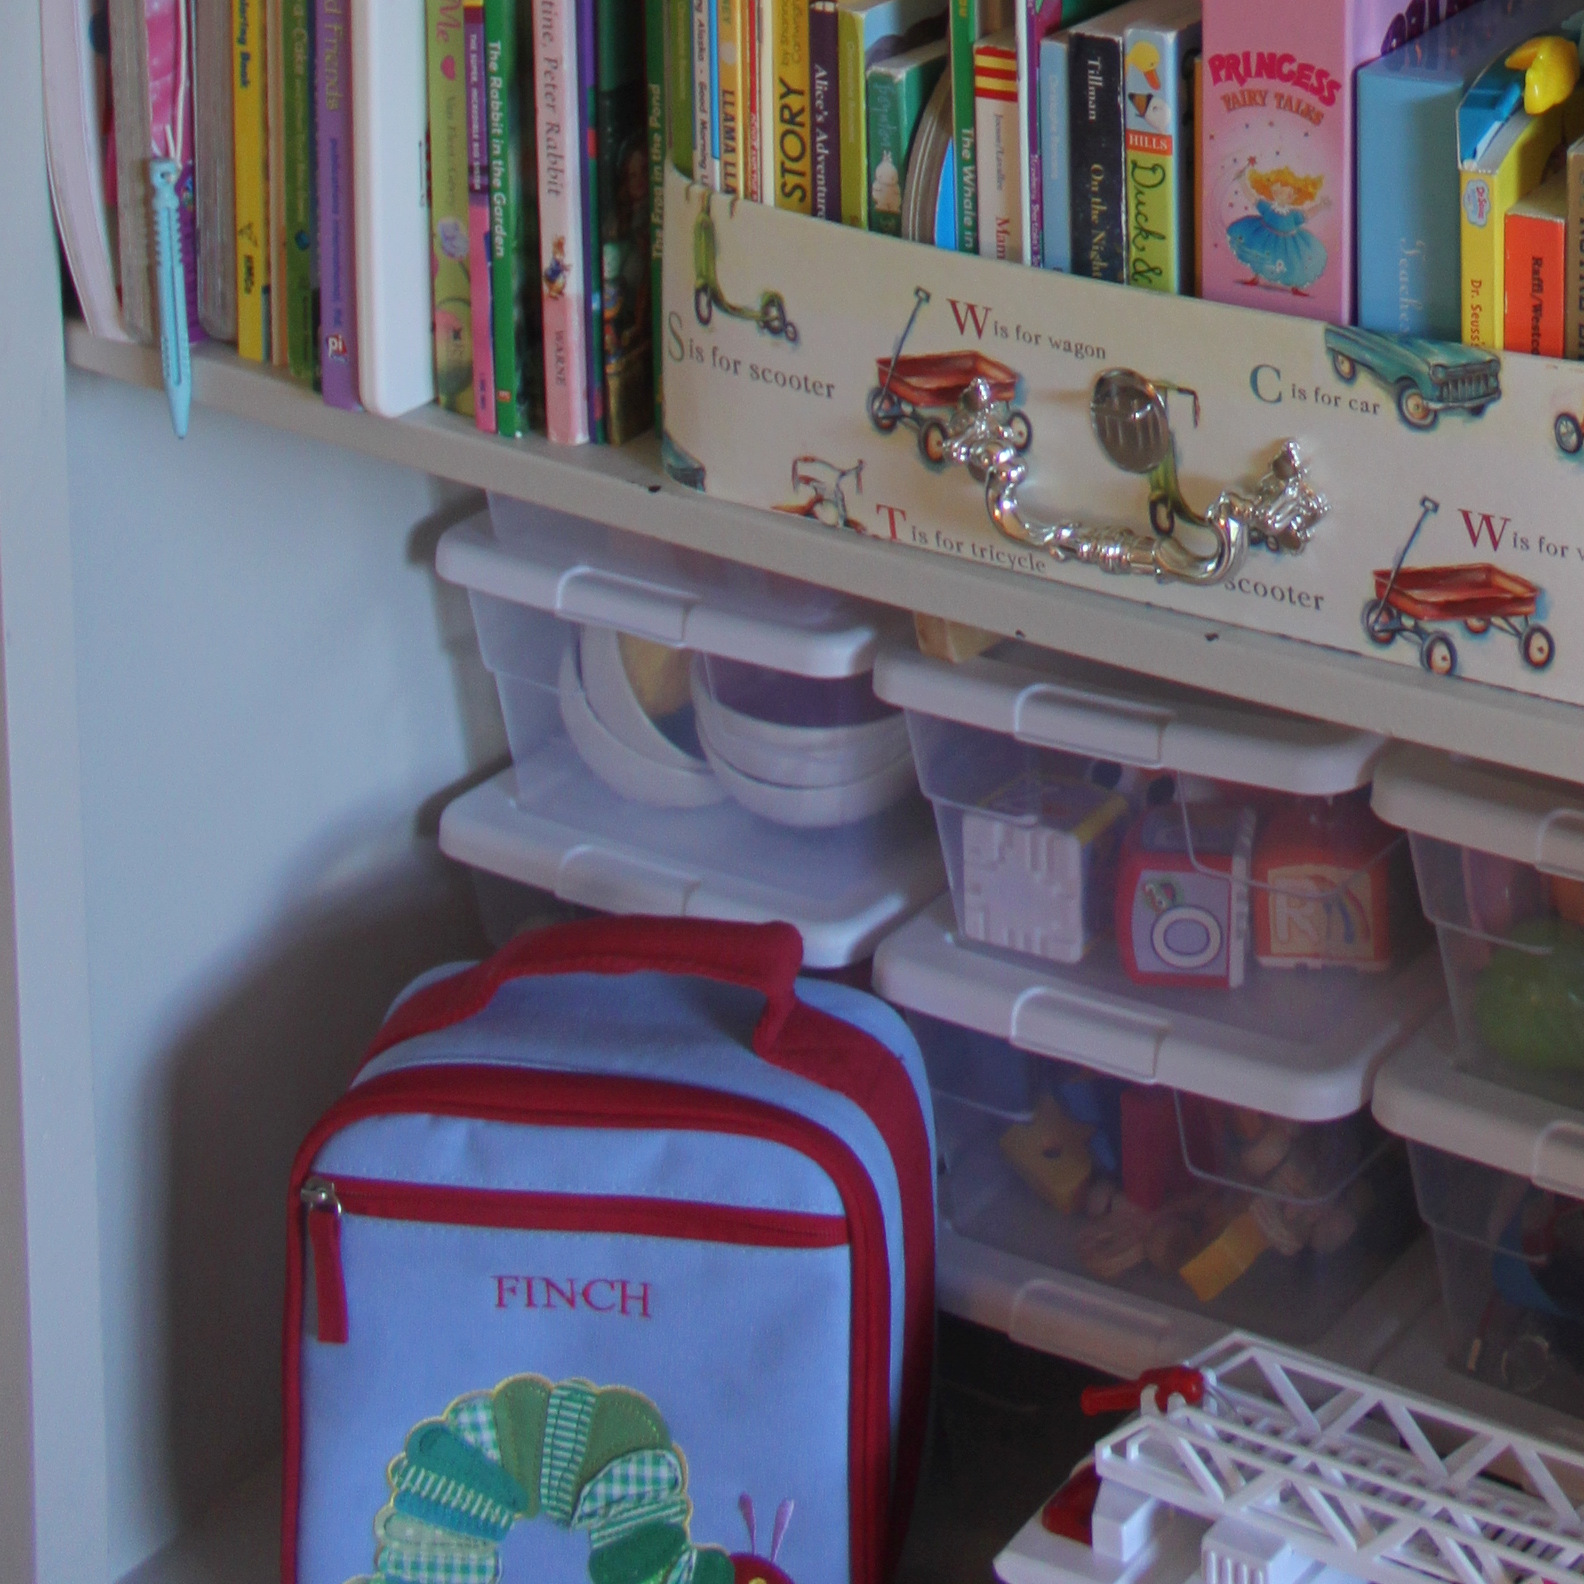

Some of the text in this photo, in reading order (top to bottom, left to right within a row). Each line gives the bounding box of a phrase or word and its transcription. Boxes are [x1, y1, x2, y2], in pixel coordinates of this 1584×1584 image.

[239, 50, 251, 89] Book
[322, 26, 344, 112] Friends
[543, 58, 558, 114] Peter
[814, 64, 828, 122] Alice's
[1087, 56, 1103, 120] Tillman
[1208, 50, 1342, 107] PRINCESS
[648, 84, 662, 161] the Pond
[1221, 89, 1325, 126] FAIRY TALES
[487, 40, 506, 259] The Rabbit the Garden
[544, 121, 564, 196] Rabbit
[779, 78, 806, 203] STORY
[1129, 133, 1168, 151] HILLS
[961, 127, 976, 228] The Whale
[1091, 164, 1106, 220] On the
[1130, 159, 1166, 257] Duck
[1470, 279, 1482, 298] Dr.
[668, 310, 835, 399] S is for scooter
[946, 299, 1106, 361] W is for wagon
[1249, 364, 1380, 415] C is for car
[876, 503, 1047, 574] T is for tricycle
[1458, 508, 1512, 553] W
[1512, 533, 1530, 550] is
[1538, 536, 1569, 559] for
[1152, 906, 1223, 968] O
[492, 1275, 652, 1319] FINCH
